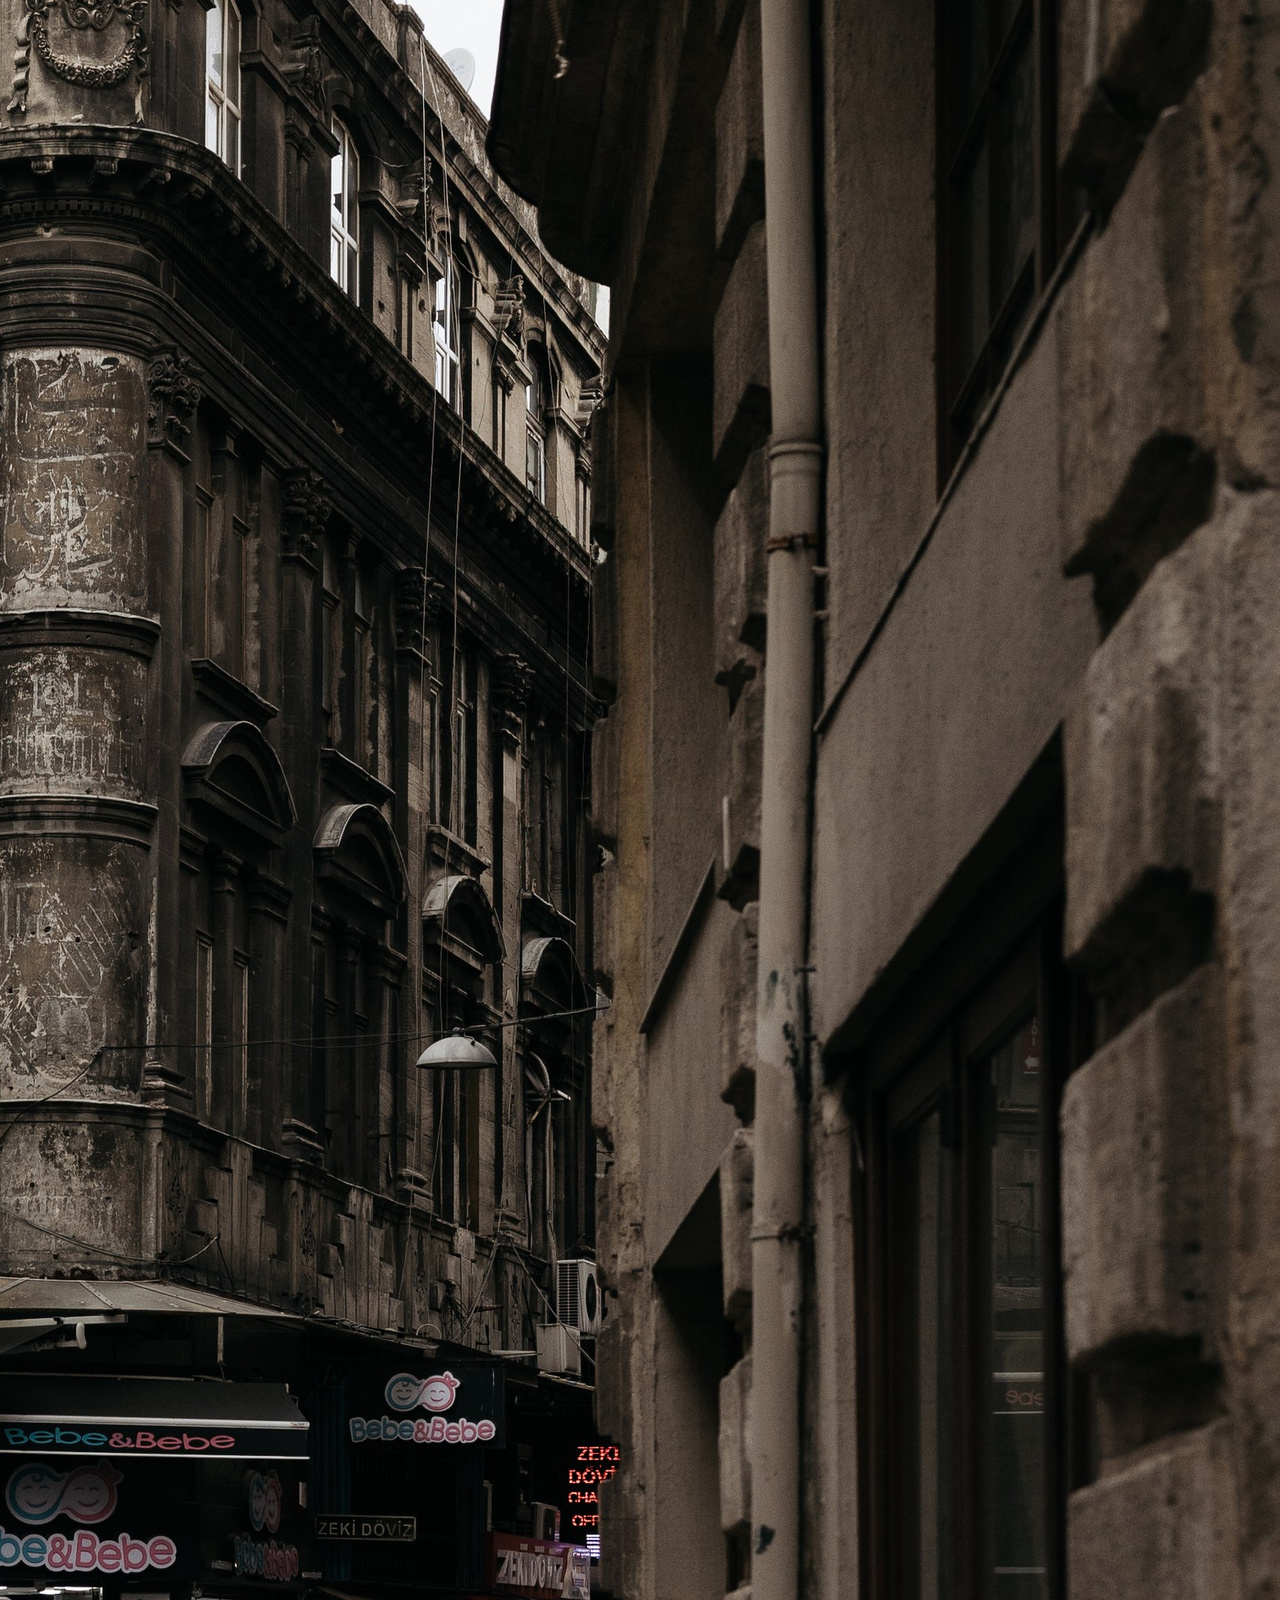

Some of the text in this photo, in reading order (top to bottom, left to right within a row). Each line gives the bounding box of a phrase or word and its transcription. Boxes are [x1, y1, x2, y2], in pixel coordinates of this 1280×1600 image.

[3, 1427, 236, 1450] Bebe&Bebe
[349, 1415, 496, 1443] Bebe&Bebe
[317, 1519, 413, 1537] ZEKİ DÖVİZ
